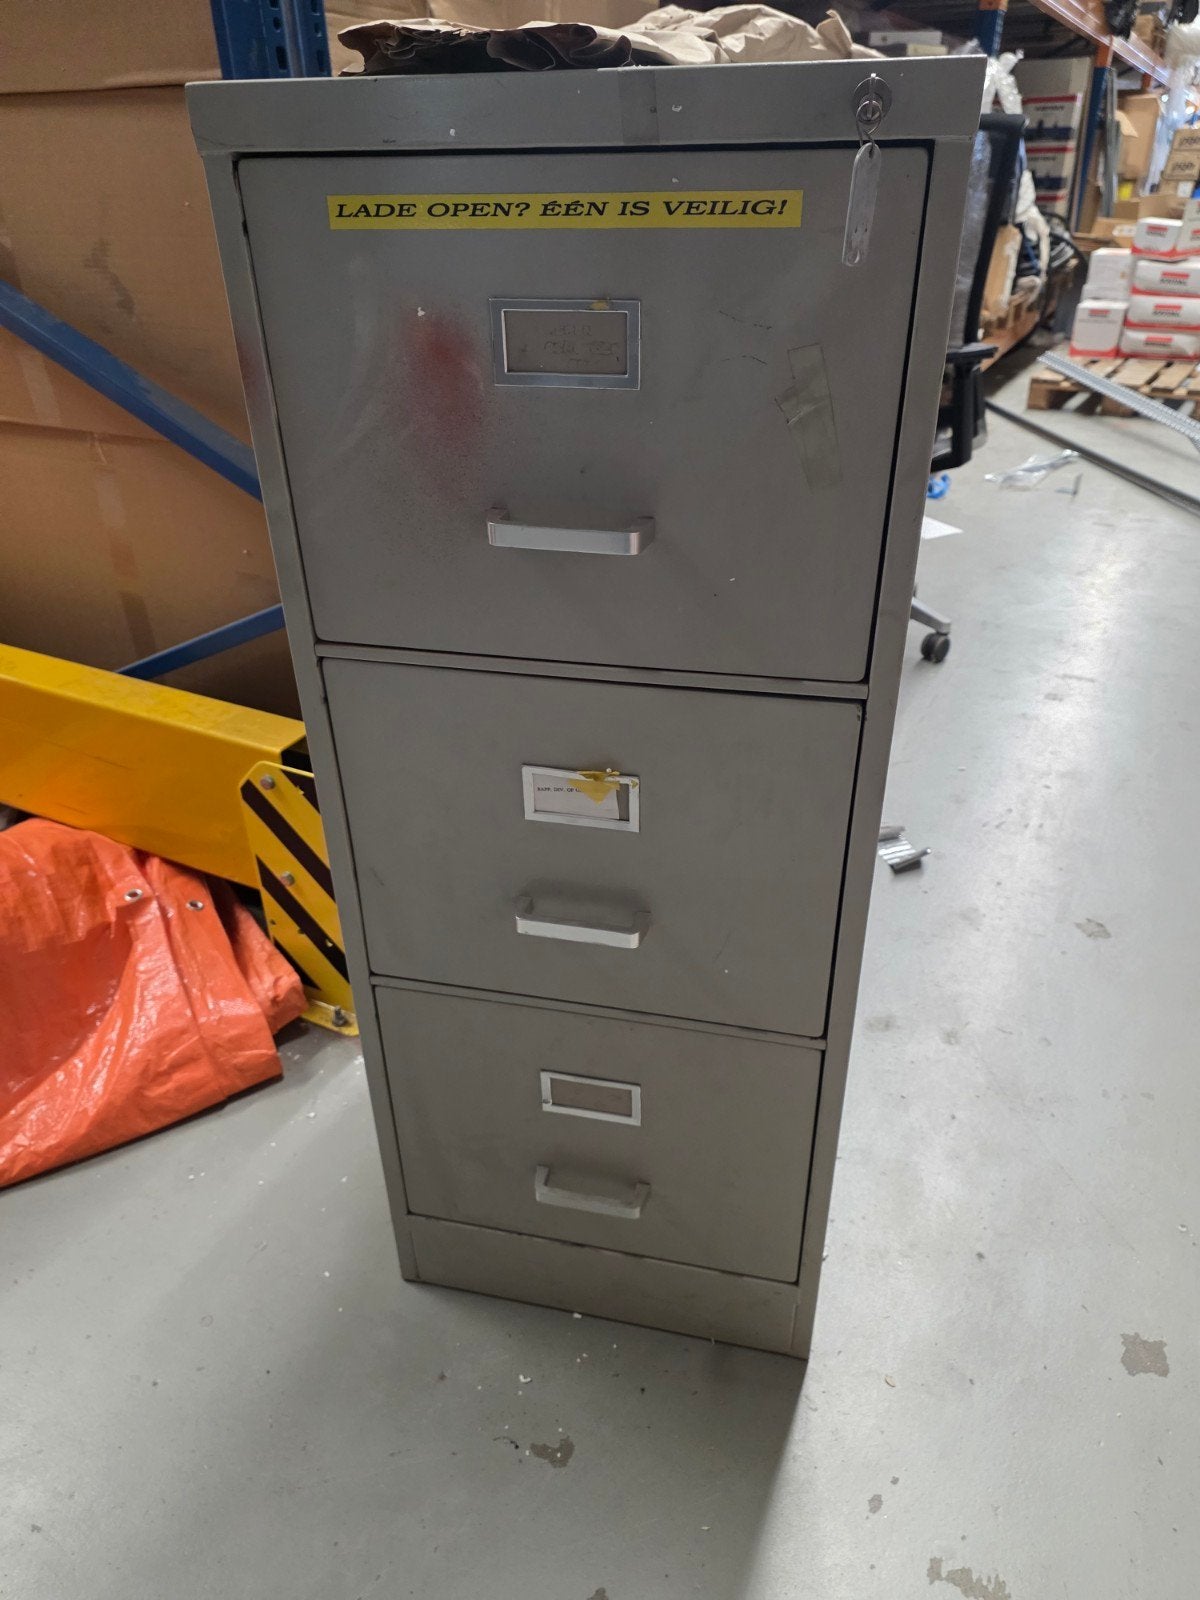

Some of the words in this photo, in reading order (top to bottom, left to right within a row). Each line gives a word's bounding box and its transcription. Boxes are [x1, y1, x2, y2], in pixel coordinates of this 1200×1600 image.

[335, 203, 417, 218] LADE
[427, 202, 531, 218] OPEN?
[539, 200, 609, 217] ÉÉN
[617, 200, 651, 217] IS
[662, 199, 788, 216] VEILIG!
